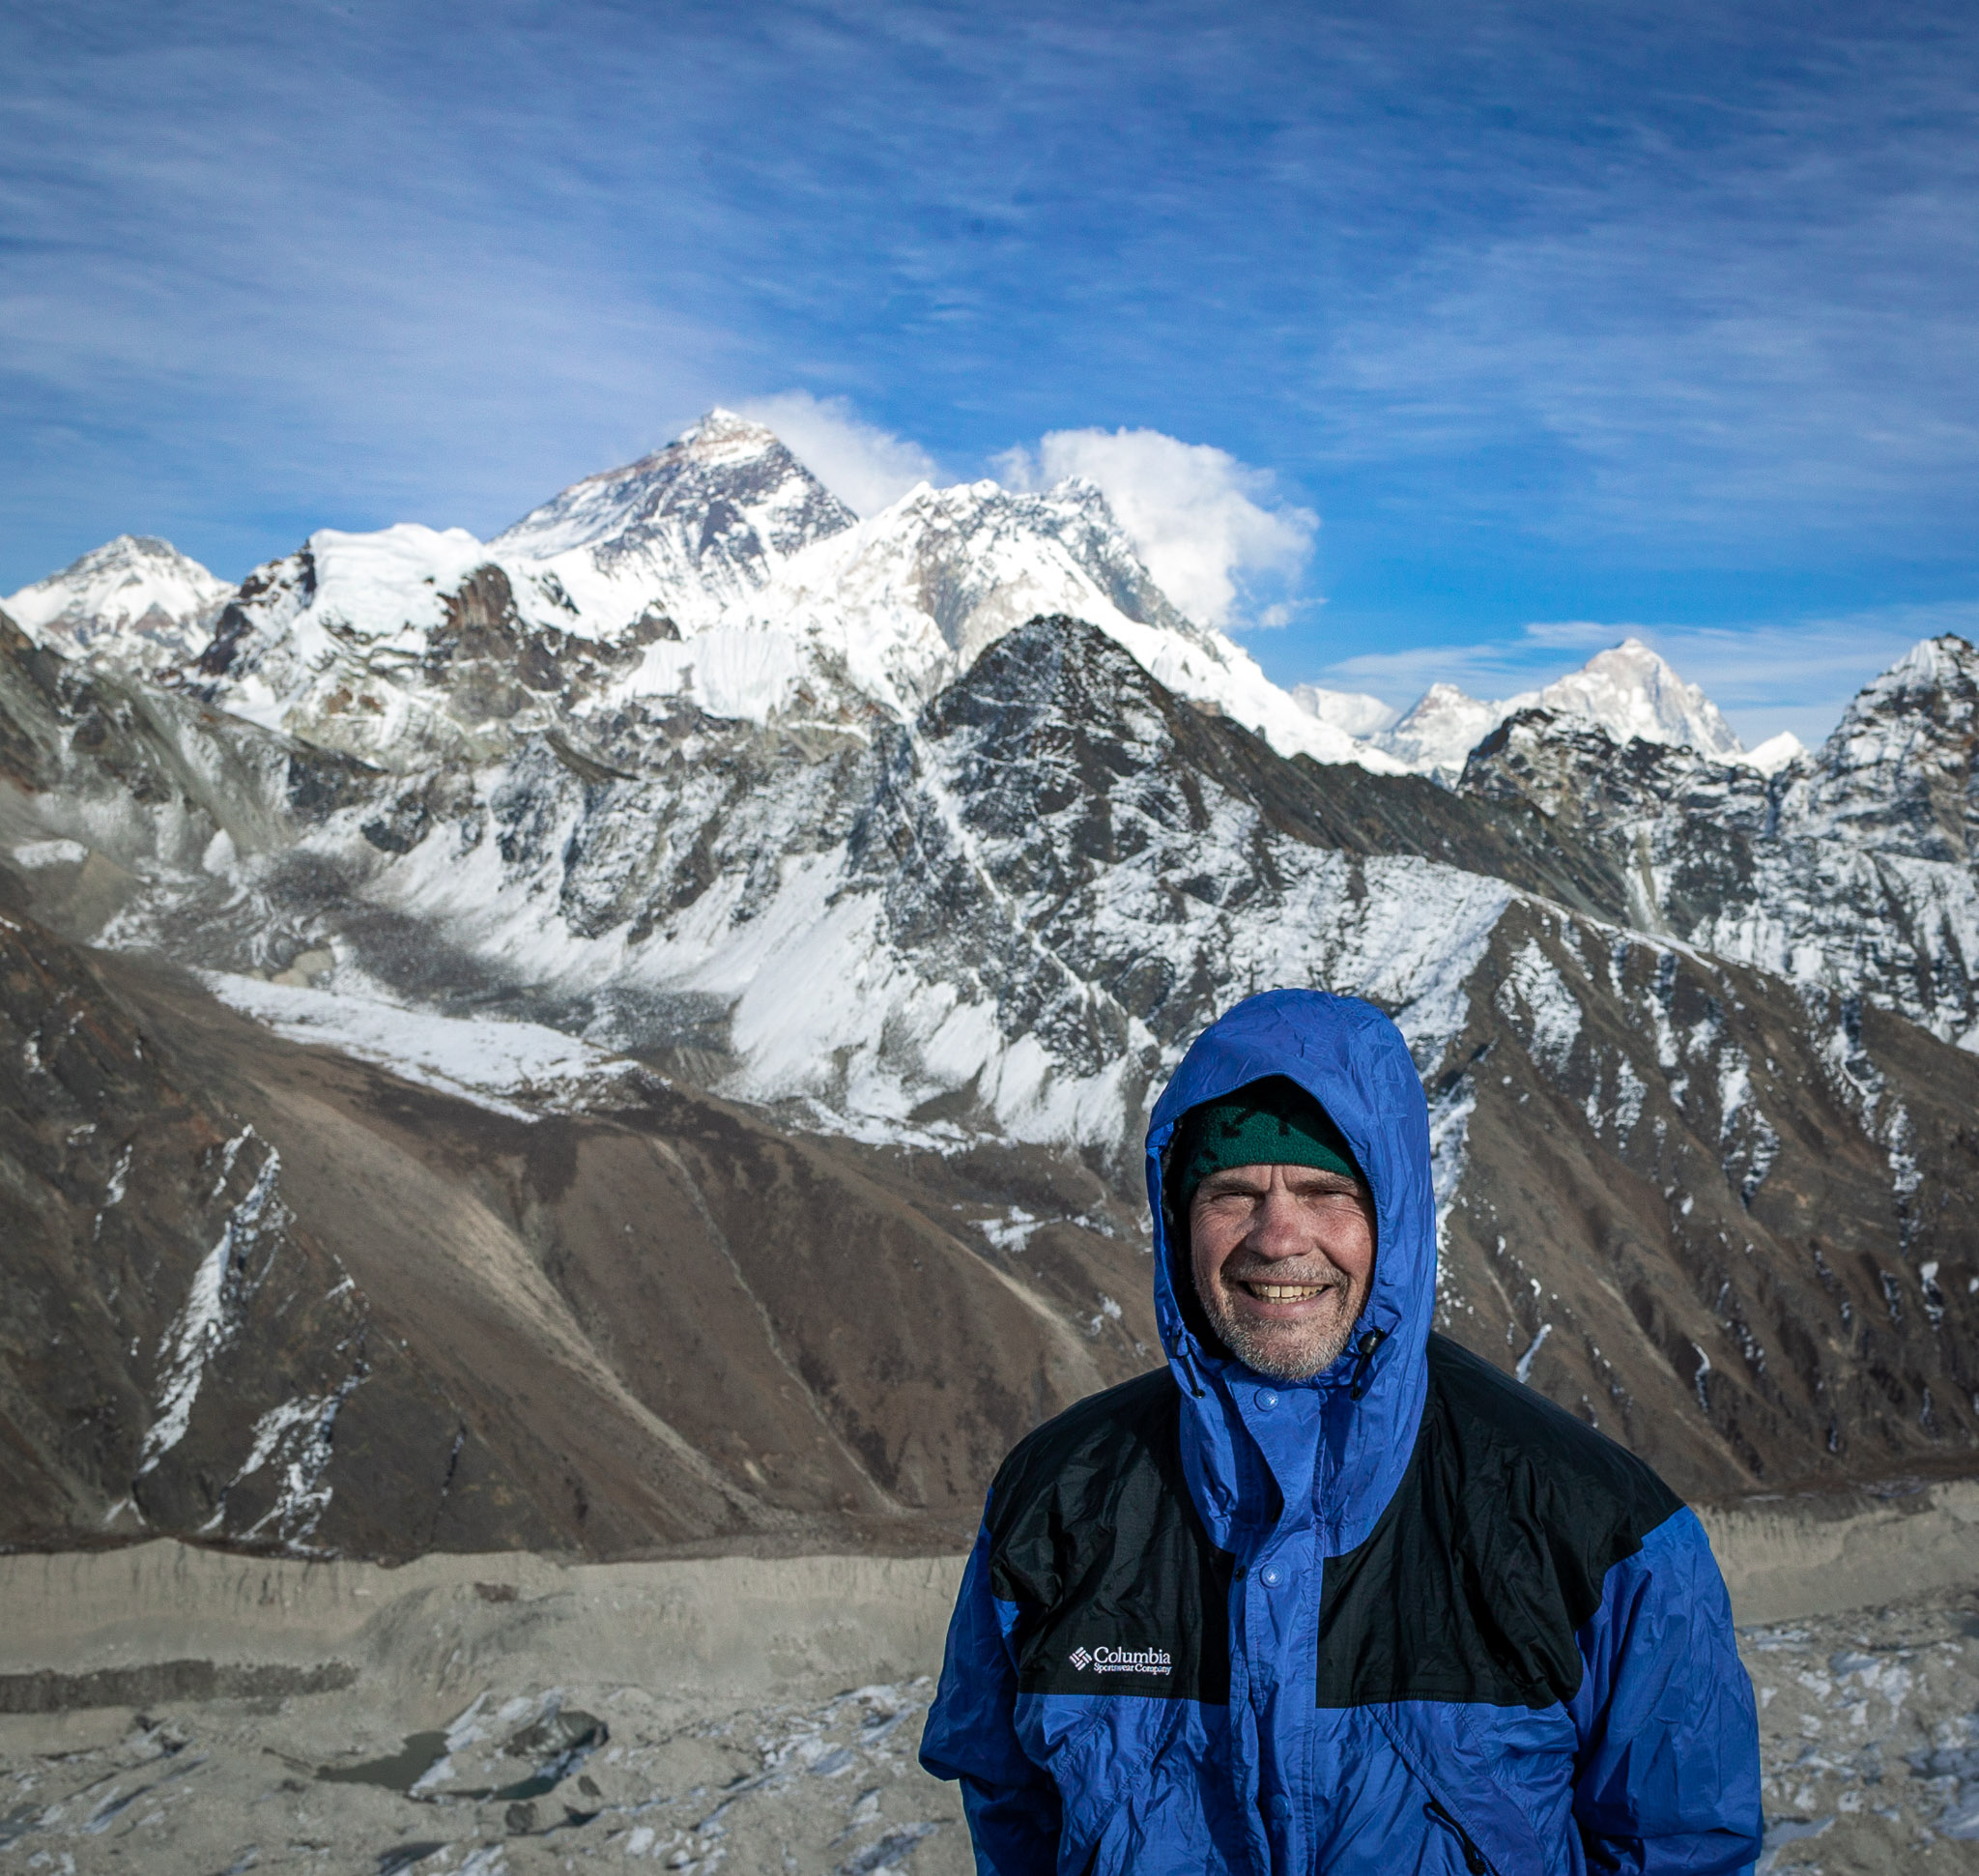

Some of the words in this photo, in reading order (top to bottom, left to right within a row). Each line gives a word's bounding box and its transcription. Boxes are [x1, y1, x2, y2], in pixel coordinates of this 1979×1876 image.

[1093, 1646, 1171, 1664] Columbia
[1094, 1662, 1133, 1674] Sportswear
[1134, 1663, 1172, 1676] Company
